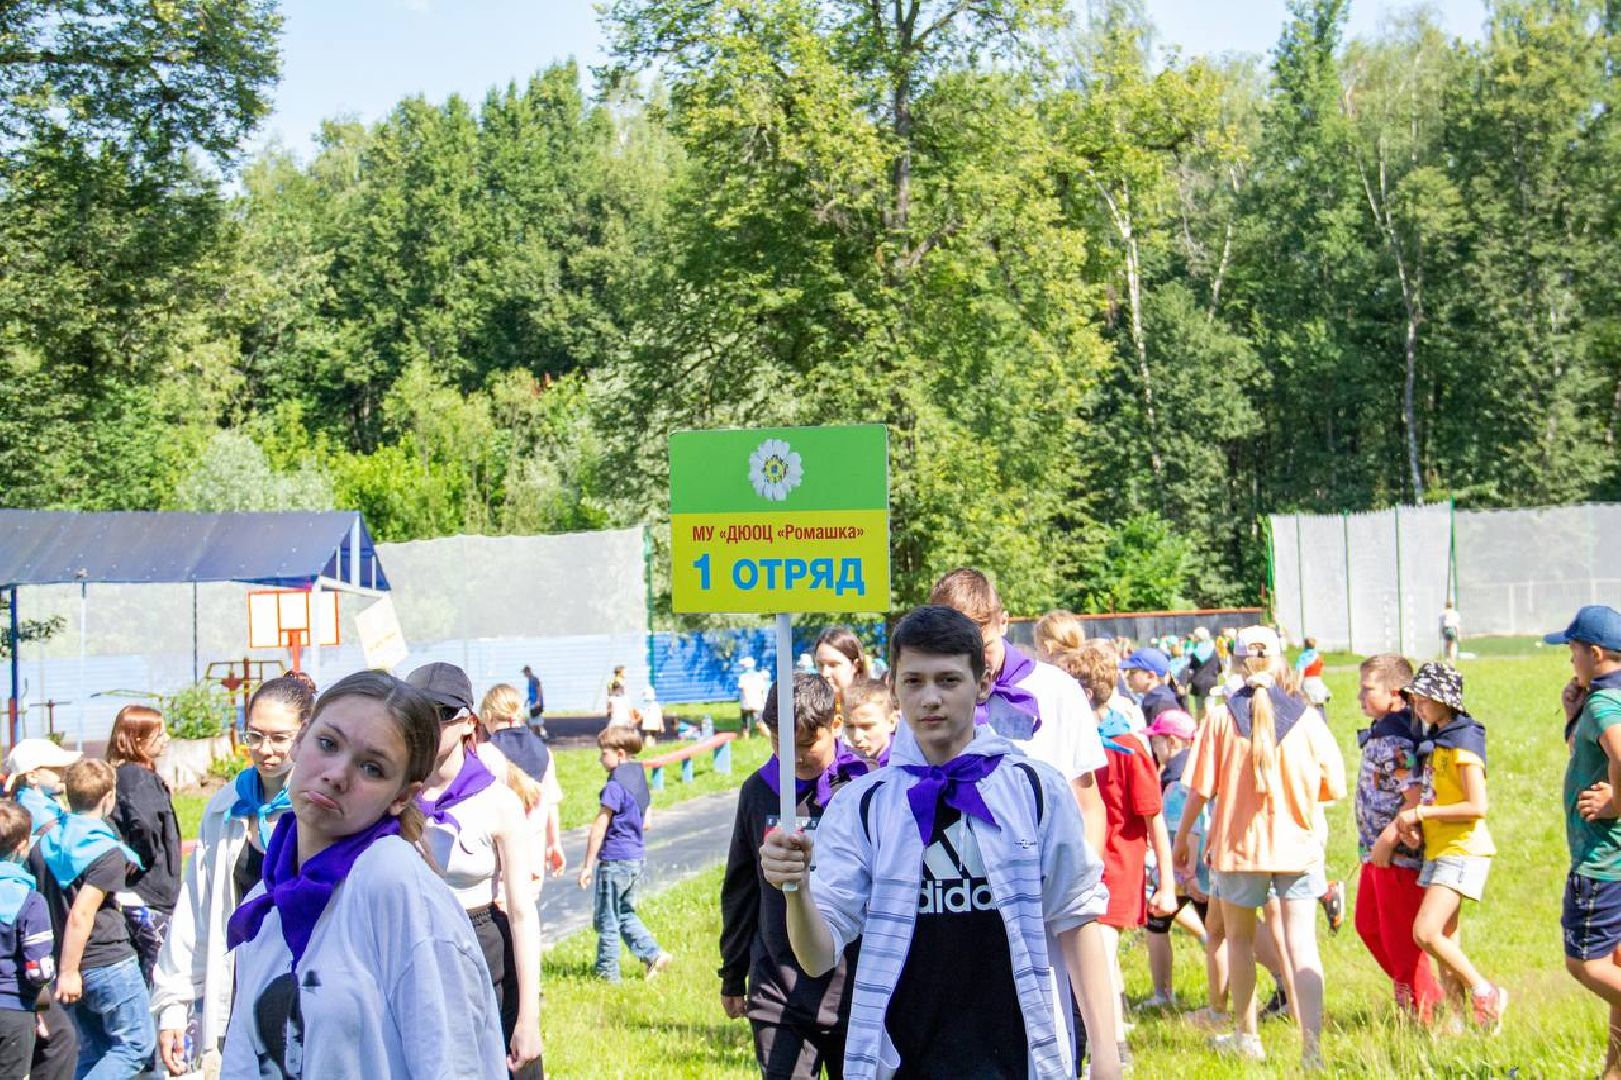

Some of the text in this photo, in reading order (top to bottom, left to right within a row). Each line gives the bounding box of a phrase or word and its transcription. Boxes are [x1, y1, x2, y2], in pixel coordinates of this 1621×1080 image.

[692, 524, 864, 543] МУ «ДЮОЦ «Ромашка»
[694, 553, 865, 596] 1 ОТРЯД
[918, 878, 997, 913] dida
